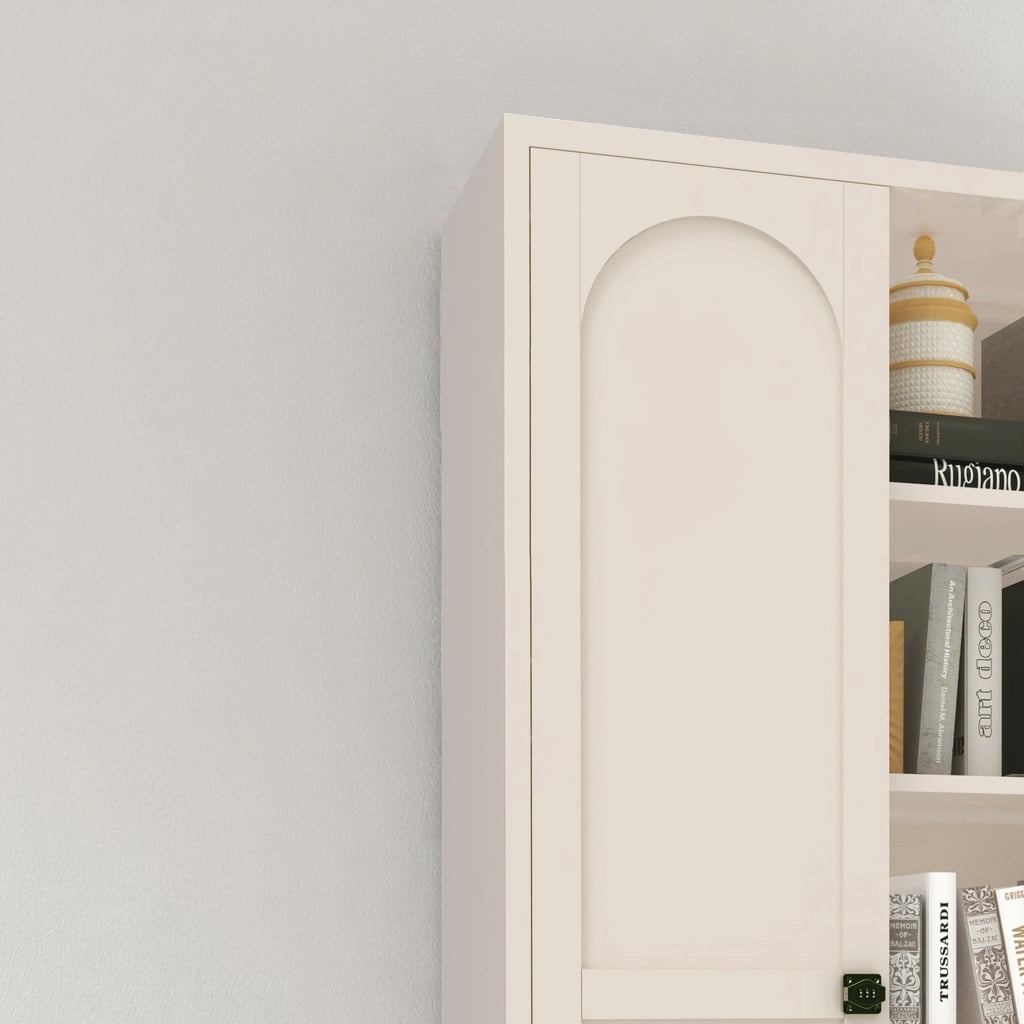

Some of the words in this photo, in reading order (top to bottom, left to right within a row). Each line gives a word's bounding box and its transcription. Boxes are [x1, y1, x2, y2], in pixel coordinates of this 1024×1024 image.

[949, 580, 956, 592] An
[944, 593, 955, 648] Architectural
[976, 600, 992, 680] deco
[940, 648, 951, 680] History
[939, 686, 948, 711] Daniel
[976, 688, 992, 739] art
[935, 723, 945, 764] Abramson
[1004, 890, 1024, 901] GRIGG
[890, 922, 918, 930] MEMOIR
[968, 916, 998, 927] MEMOIR
[939, 902, 949, 1002] TRUSSARDI
